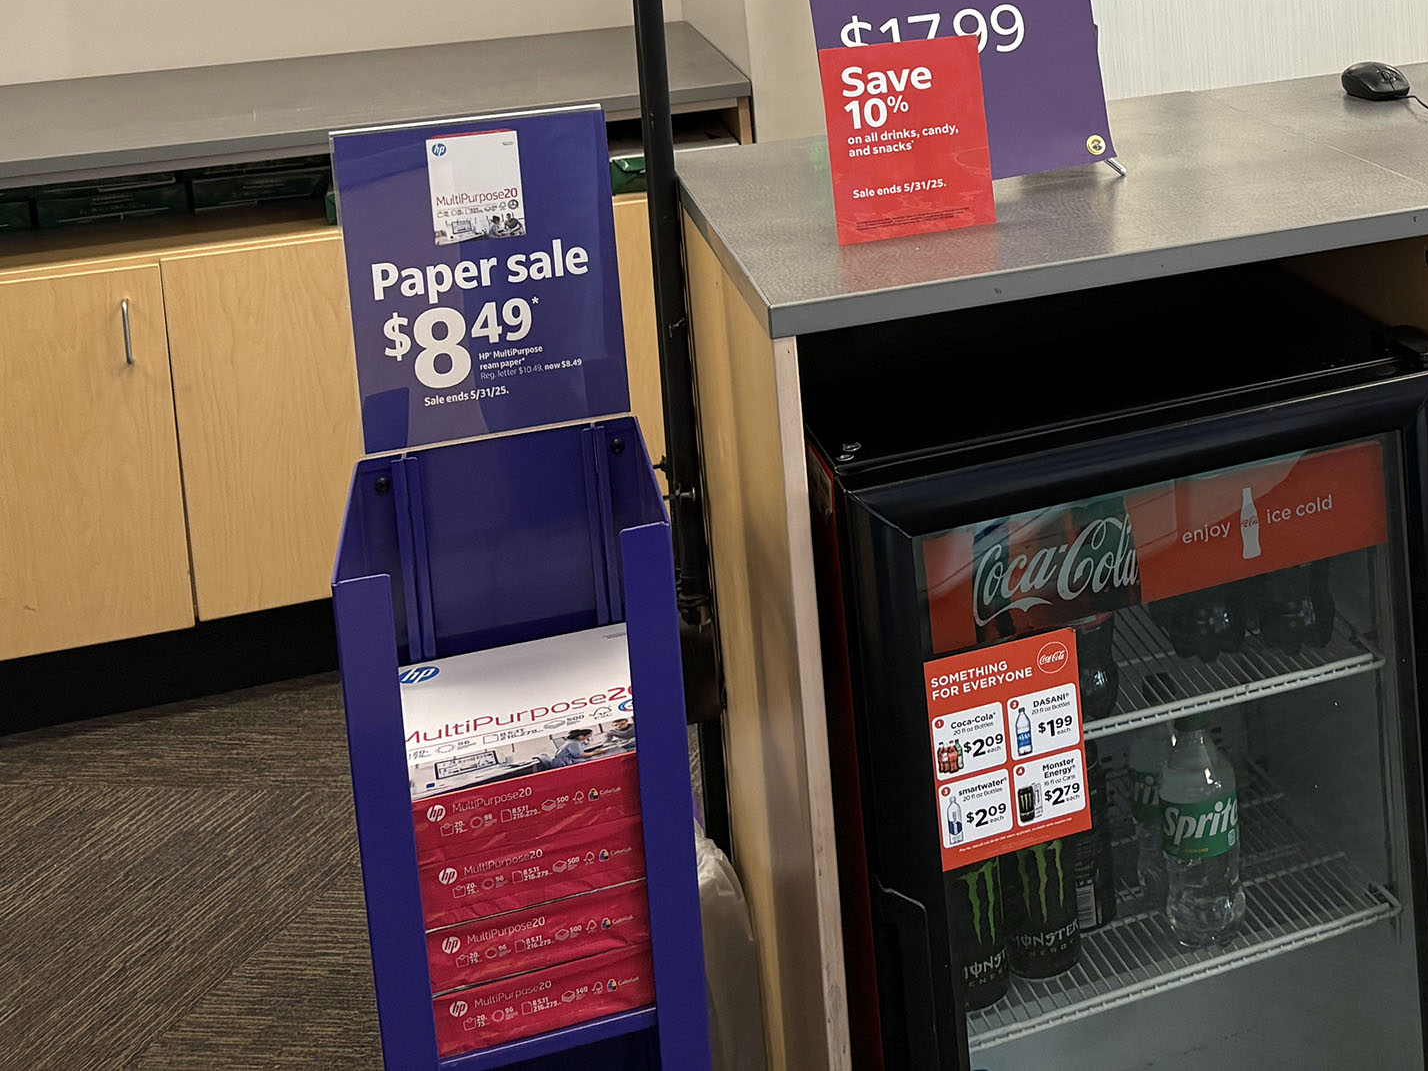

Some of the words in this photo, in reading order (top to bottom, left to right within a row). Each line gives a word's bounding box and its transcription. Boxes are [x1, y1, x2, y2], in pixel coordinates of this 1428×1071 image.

[841, 66, 933, 98] Save
[844, 95, 909, 130] 10%
[847, 135, 864, 145] on
[865, 131, 878, 143] all
[880, 128, 920, 142] drinks,
[922, 123, 960, 137] candy,
[849, 146, 870, 158] and
[436, 188, 518, 206] MultiPurpose20
[852, 188, 875, 199] Sale
[877, 184, 902, 195] ends
[904, 179, 947, 193] 5/31/25.
[372, 256, 497, 304] Paper
[507, 239, 589, 283] sale
[493, 345, 543, 359] MultiPurpose
[480, 361, 499, 371] ream
[544, 362, 560, 371] now
[561, 358, 582, 369] $8.49
[424, 396, 444, 407] Sale
[446, 392, 469, 403] ends
[470, 385, 509, 400] 5/31/25.
[1266, 505, 1292, 525] ice
[1296, 495, 1333, 518] cold
[1182, 519, 1231, 544] enjoy
[973, 512, 1138, 626] Coca-Cola
[400, 667, 440, 684] hp
[931, 661, 1008, 688] SOMETHING
[931, 686, 959, 700] FOR
[963, 667, 1033, 693] EVERYONE
[1057, 727, 1071, 735] each
[987, 745, 1001, 754] each
[1043, 757, 1074, 772] Monster
[452, 787, 532, 813] MultiPurpose20
[1066, 795, 1080, 803] each
[427, 805, 446, 822] hp
[990, 816, 1004, 824] each
[463, 848, 543, 876] MultiPurpose20
[438, 867, 457, 885] hp
[466, 916, 545, 944] MultiPurpose20
[441, 936, 460, 954] hp
[474, 981, 551, 1008] MultiPurpose20
[449, 1000, 468, 1017] hp
